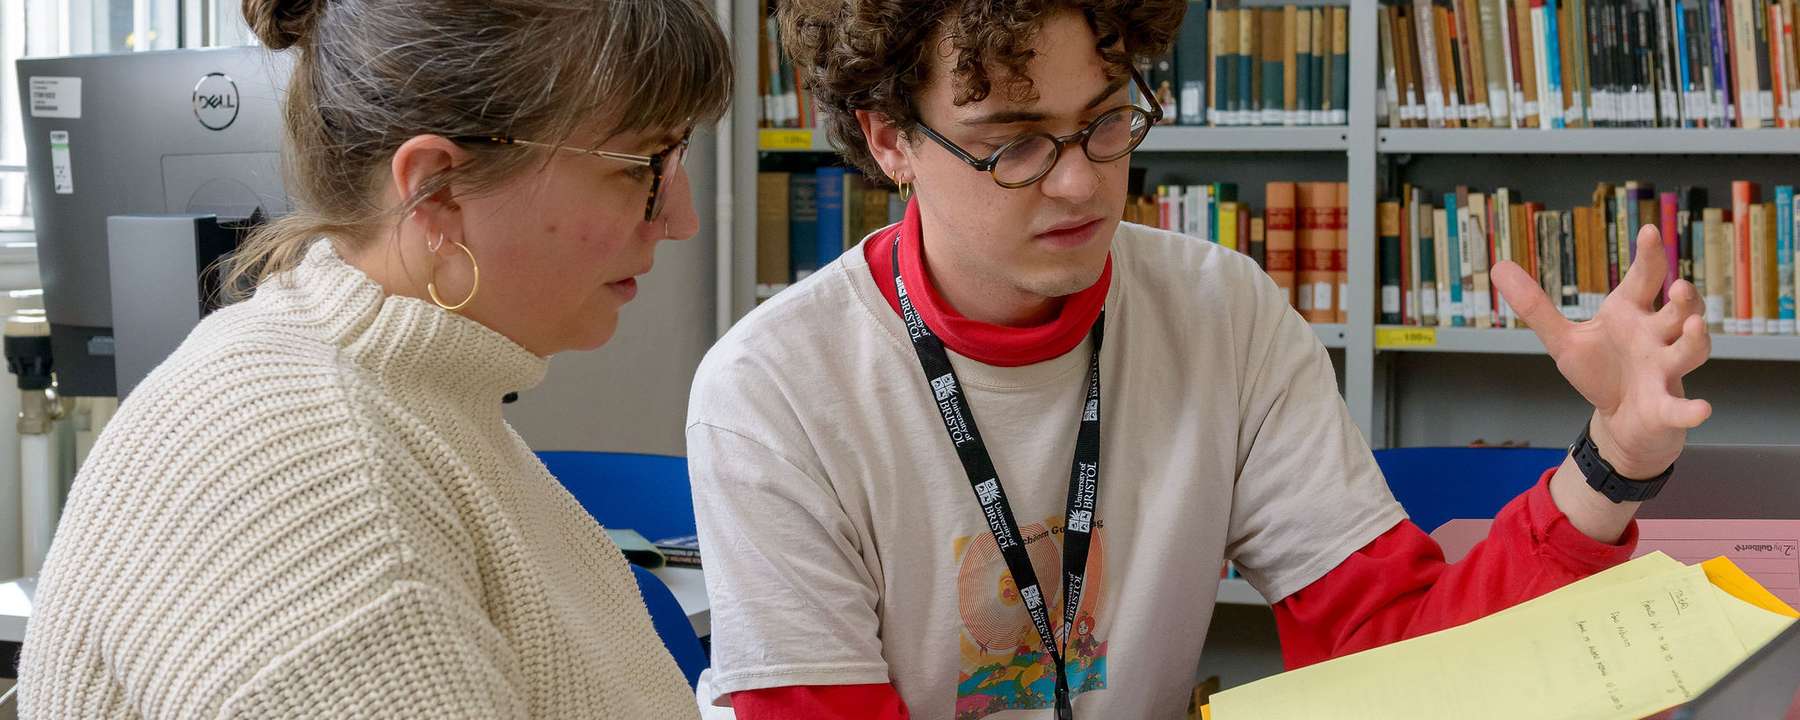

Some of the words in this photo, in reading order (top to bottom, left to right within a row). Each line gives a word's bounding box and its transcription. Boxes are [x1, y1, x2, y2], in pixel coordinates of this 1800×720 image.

[199, 94, 236, 110] DELL
[900, 296, 922, 343] BRISTOL
[921, 328, 931, 337] of
[939, 401, 966, 448] BRISTOL
[949, 396, 969, 433] University
[964, 432, 975, 441] of
[1079, 461, 1087, 471] of
[1083, 461, 1097, 509] BRISTOL
[1074, 471, 1087, 508] University
[984, 505, 1010, 552] BRISTOL
[994, 501, 1012, 538] University
[1008, 537, 1018, 546] of
[1741, 544, 1773, 552] Guilbert
[1069, 575, 1082, 620] BRISTOL
